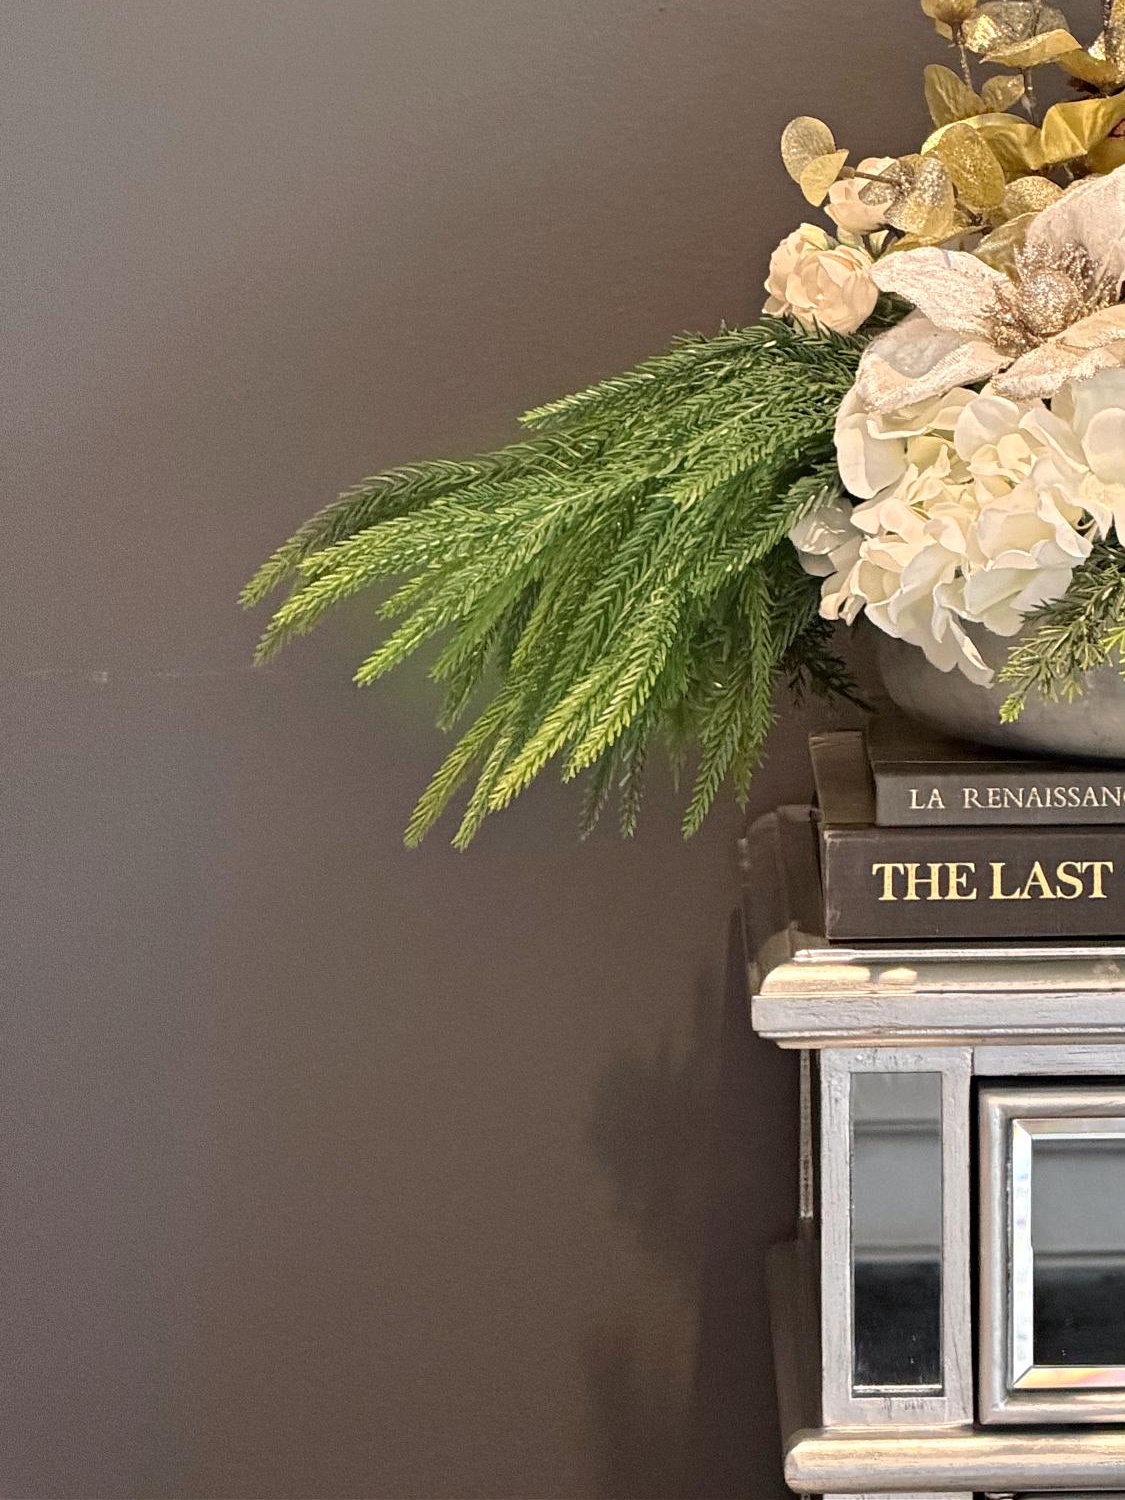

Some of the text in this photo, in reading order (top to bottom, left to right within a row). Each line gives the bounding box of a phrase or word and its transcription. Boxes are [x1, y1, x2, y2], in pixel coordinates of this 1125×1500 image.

[909, 788, 945, 809] LA
[872, 861, 977, 901] THE
[989, 860, 1113, 900] LAST
